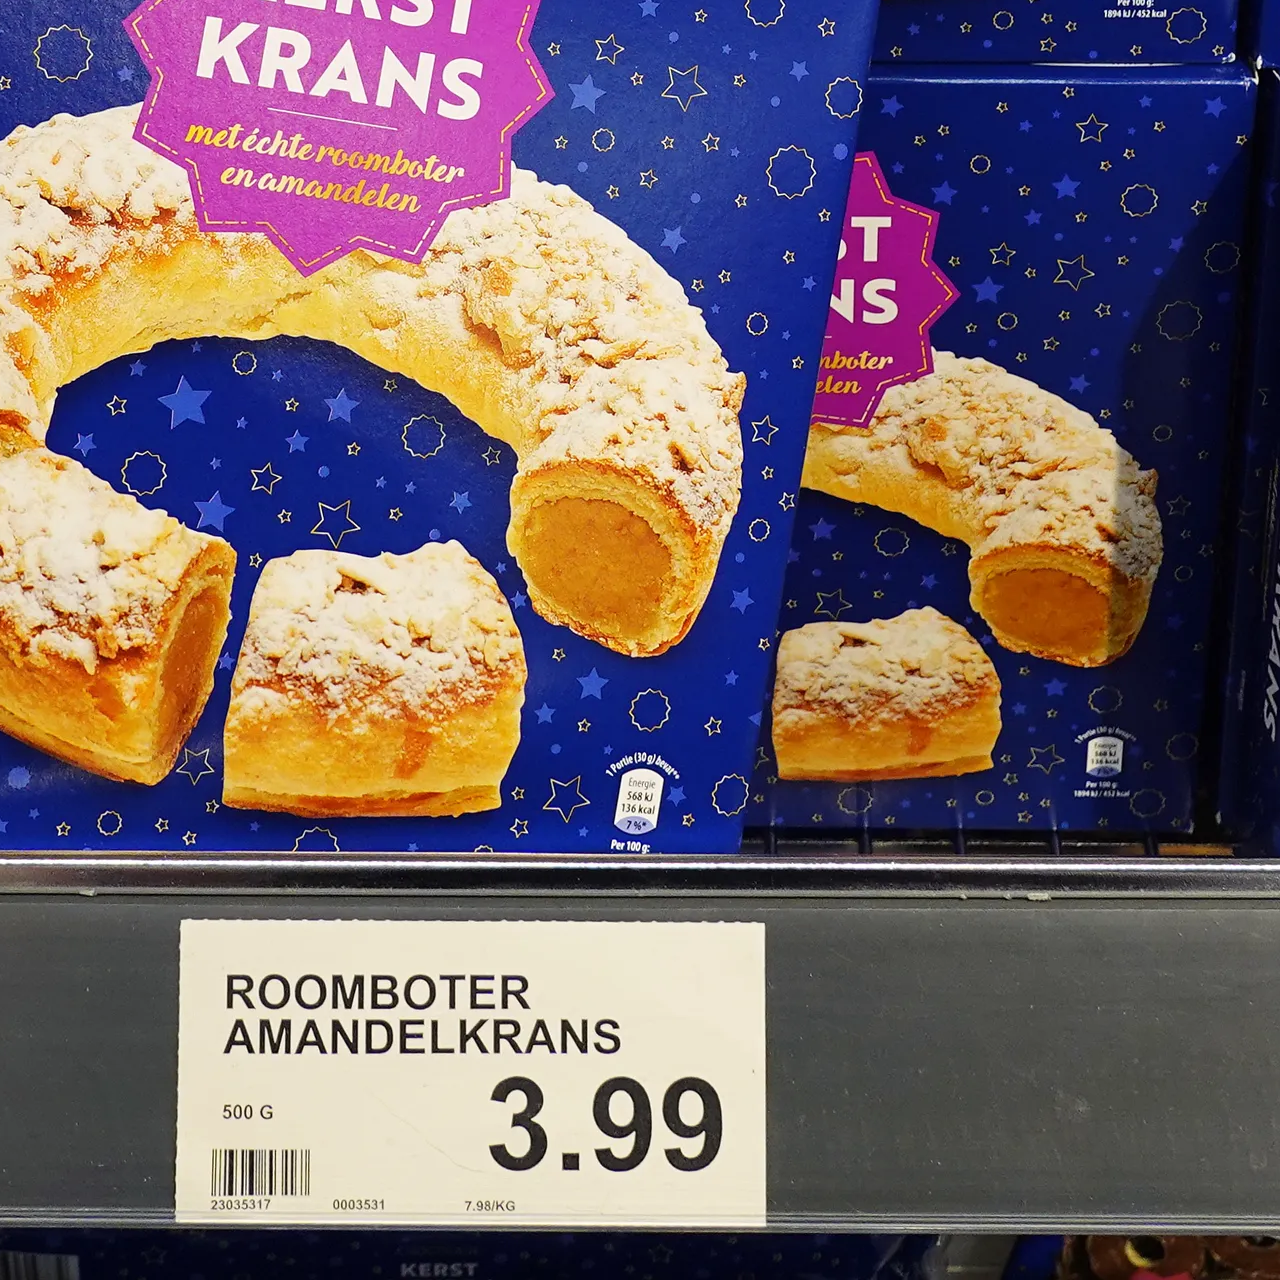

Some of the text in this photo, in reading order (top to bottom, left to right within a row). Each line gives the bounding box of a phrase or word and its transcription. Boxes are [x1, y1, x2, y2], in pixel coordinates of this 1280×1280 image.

[1104, 10, 1121, 18] 1894
[196, 16, 484, 121] KRANS
[184, 123, 244, 150] met
[316, 143, 464, 184] roomboter
[221, 166, 421, 213] en amandelen
[629, 777, 656, 790] Energie
[627, 792, 653, 802] 568 kJ
[622, 803, 655, 814] 136 kcal
[611, 840, 625, 850] Per
[627, 841, 640, 851] 100
[226, 975, 531, 1010] ROOMBOTER
[223, 1018, 622, 1054] AMANDELKRANS
[222, 1104, 274, 1121] 500 G
[489, 1076, 723, 1173] 3.99
[210, 1199, 271, 1212] 23035317
[332, 1199, 386, 1212] 0003531
[464, 1200, 516, 1213] 7.98/KG
